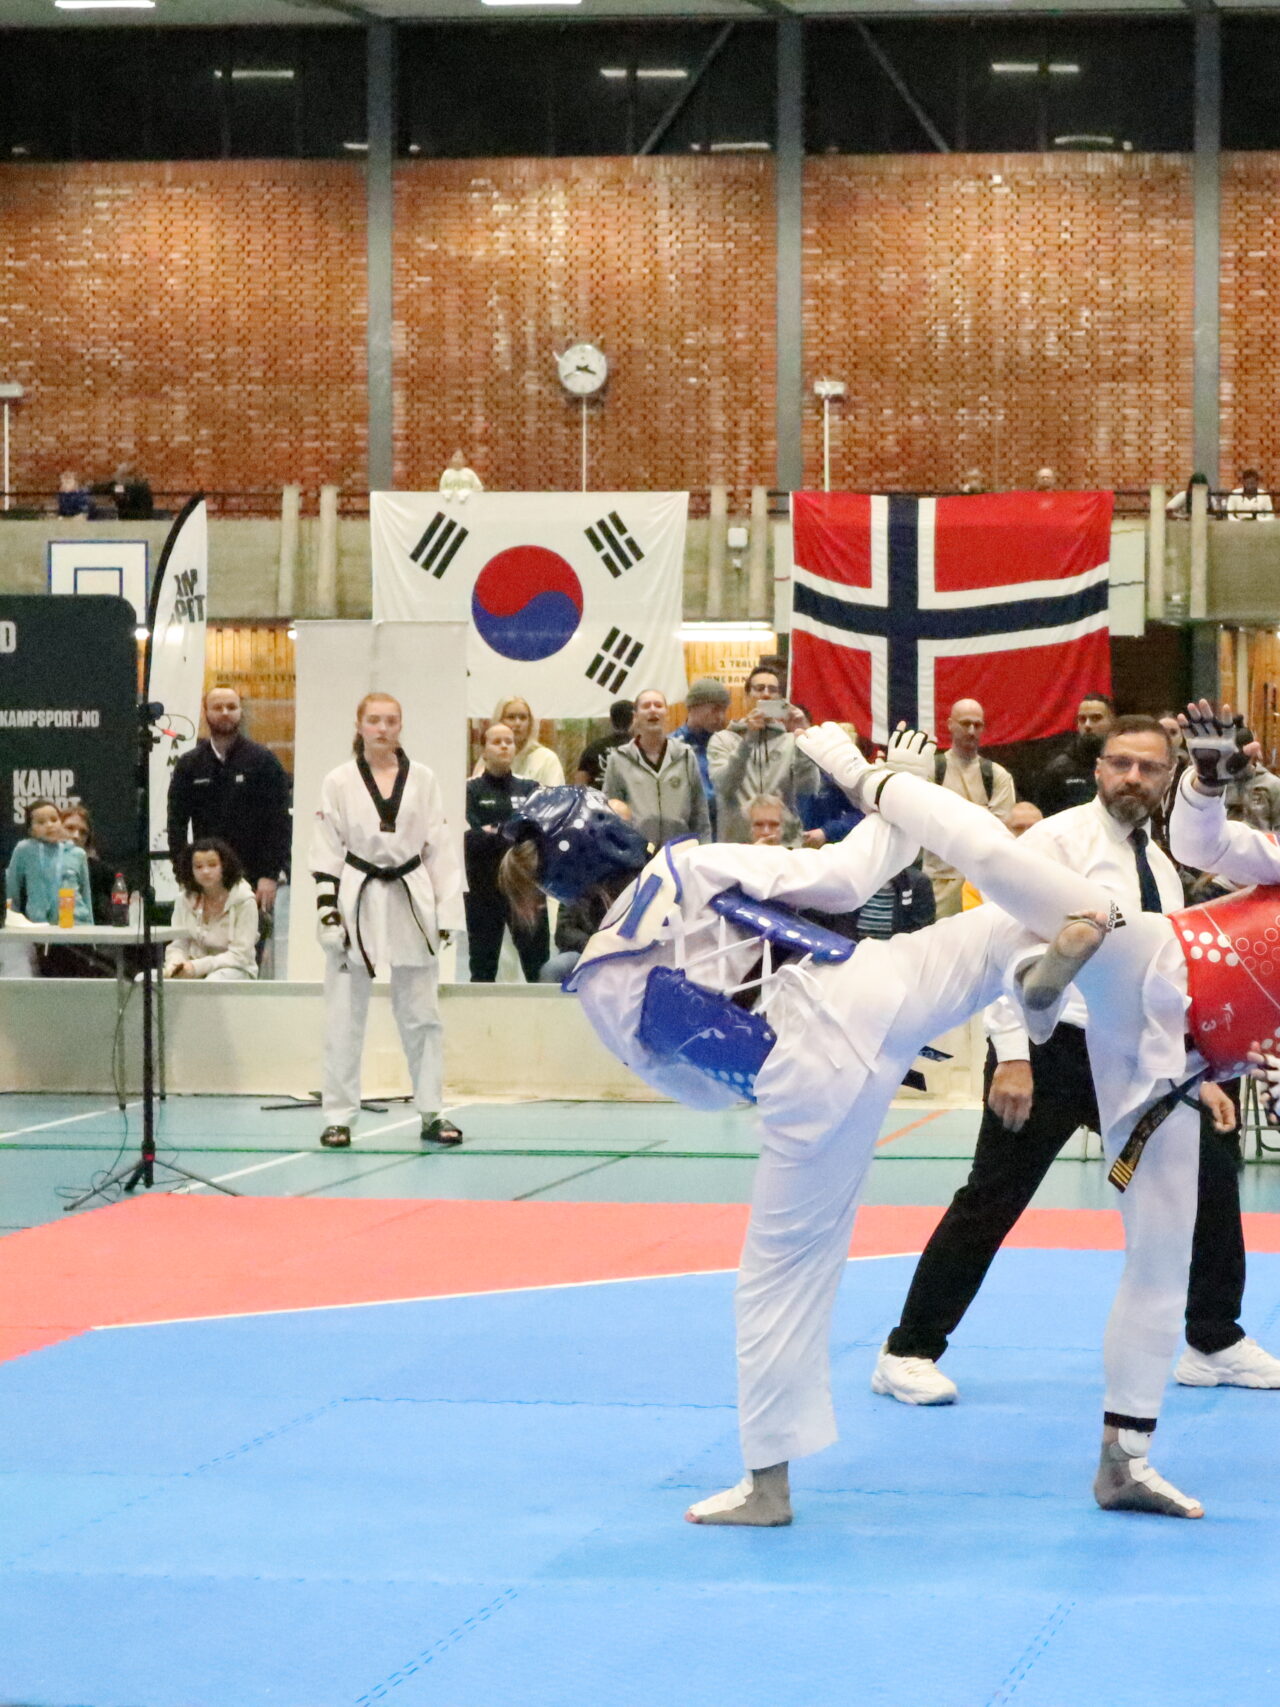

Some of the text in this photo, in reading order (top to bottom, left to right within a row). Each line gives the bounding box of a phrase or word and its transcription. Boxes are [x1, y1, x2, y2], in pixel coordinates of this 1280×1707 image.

[0, 709, 100, 727] KAMPSPORT.NO
[13, 769, 74, 797] KAMP
[13, 796, 82, 825] SRT
